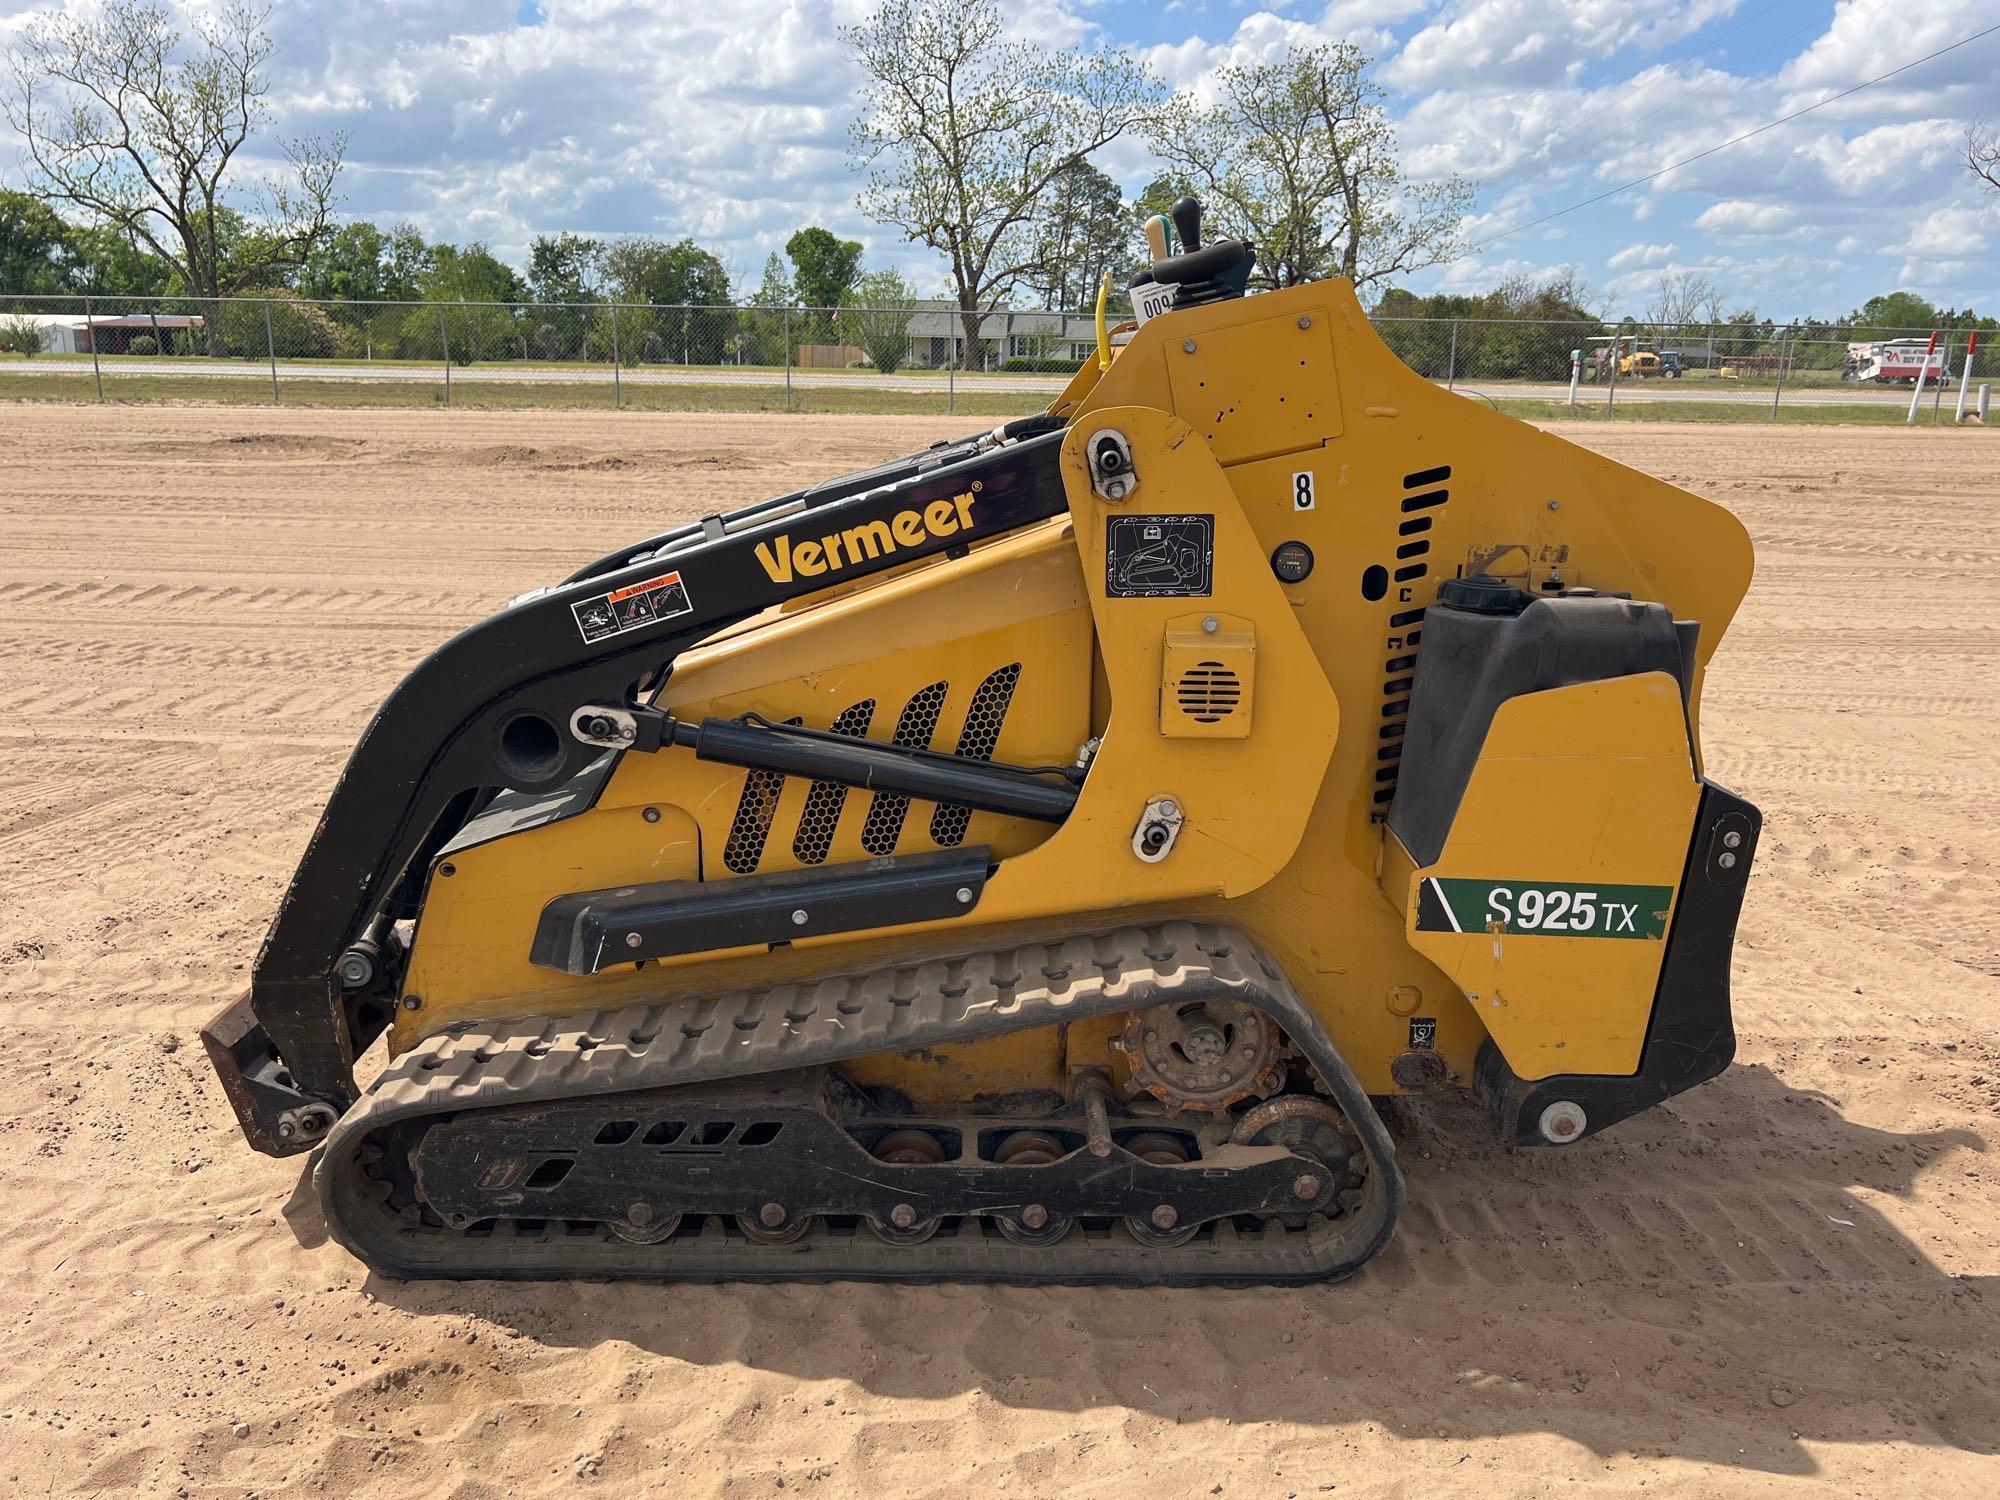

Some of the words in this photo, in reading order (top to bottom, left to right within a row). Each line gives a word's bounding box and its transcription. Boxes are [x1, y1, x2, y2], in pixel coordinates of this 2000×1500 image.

[1296, 473, 1311, 508] 8
[754, 490, 976, 584] Vermeer
[631, 579, 665, 594] WARNING
